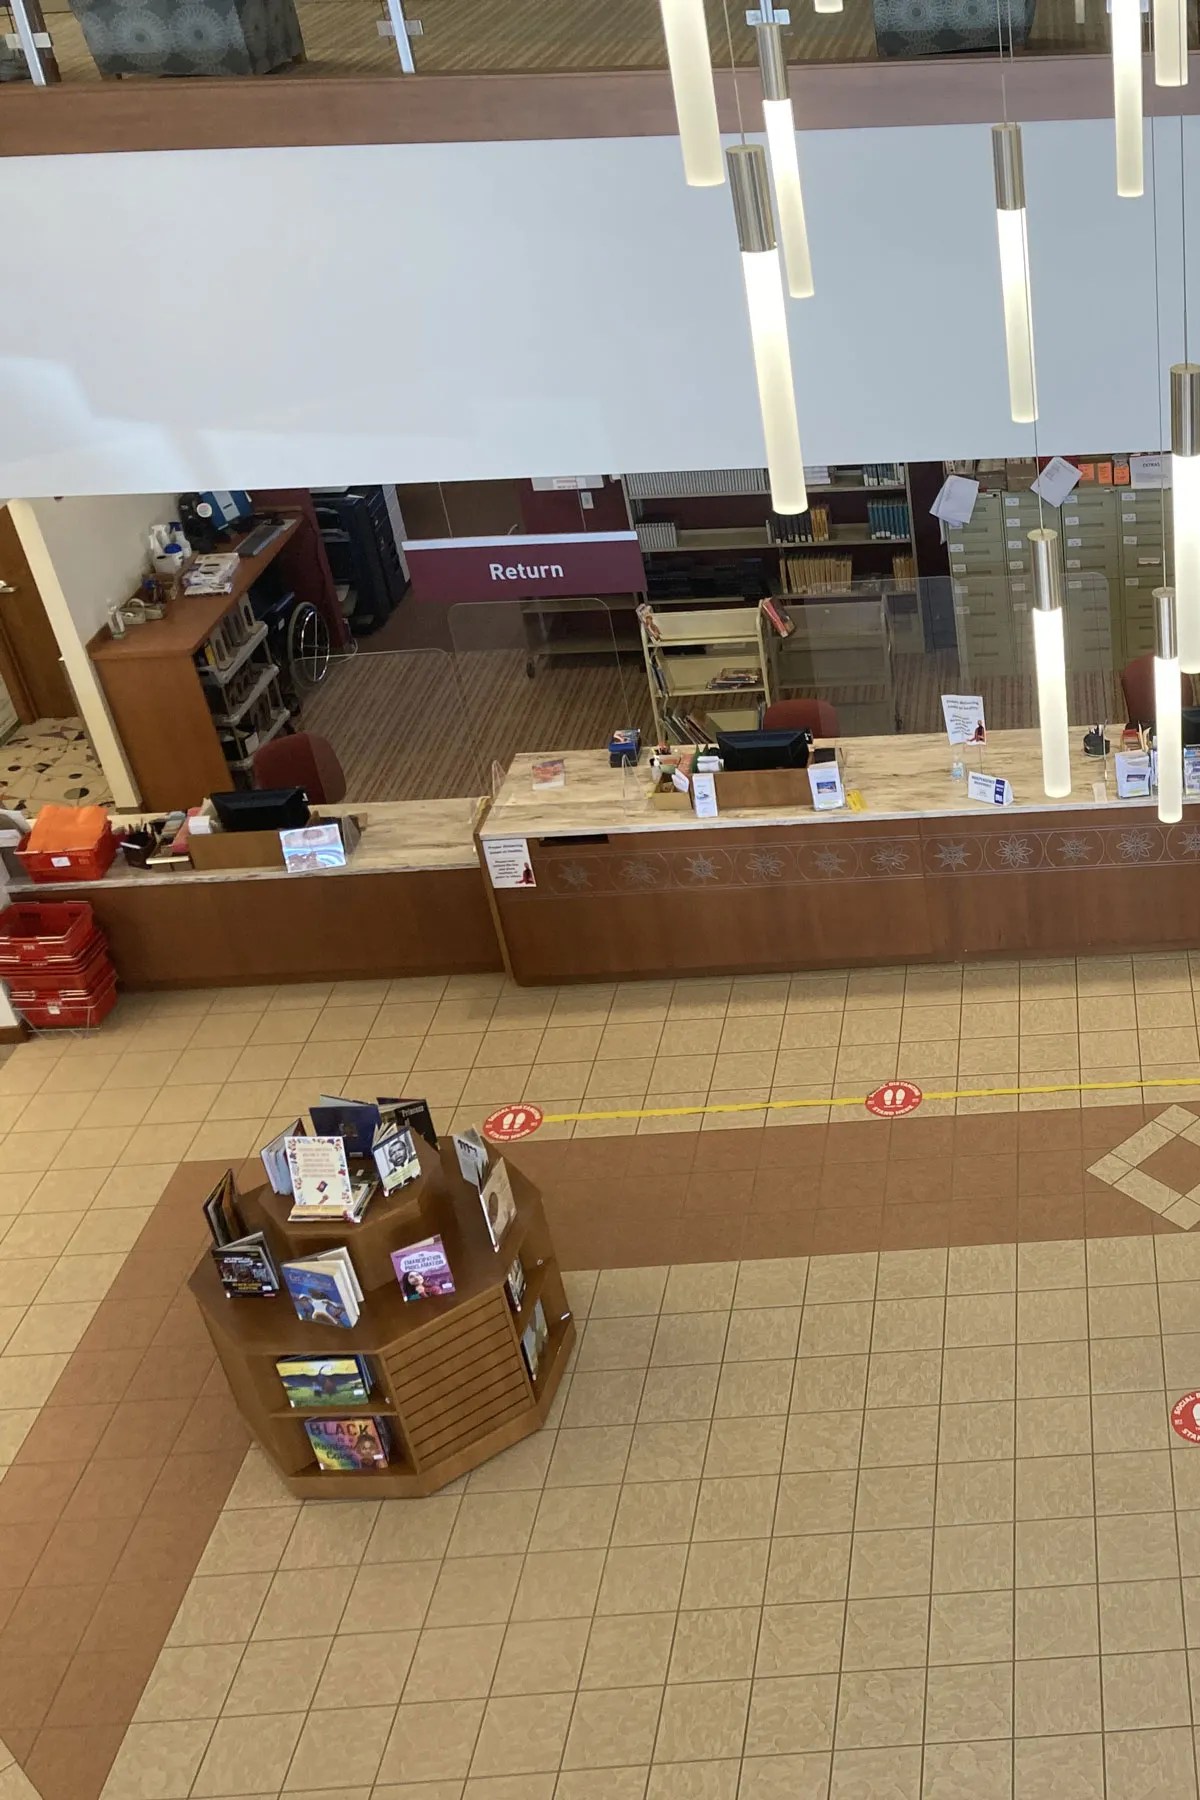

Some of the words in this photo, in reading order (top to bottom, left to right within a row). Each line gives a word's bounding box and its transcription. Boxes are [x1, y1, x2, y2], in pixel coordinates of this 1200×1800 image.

[488, 563, 564, 581] Return
[1174, 1395, 1196, 1416] SOCIAL
[309, 1423, 369, 1436] BLACK
